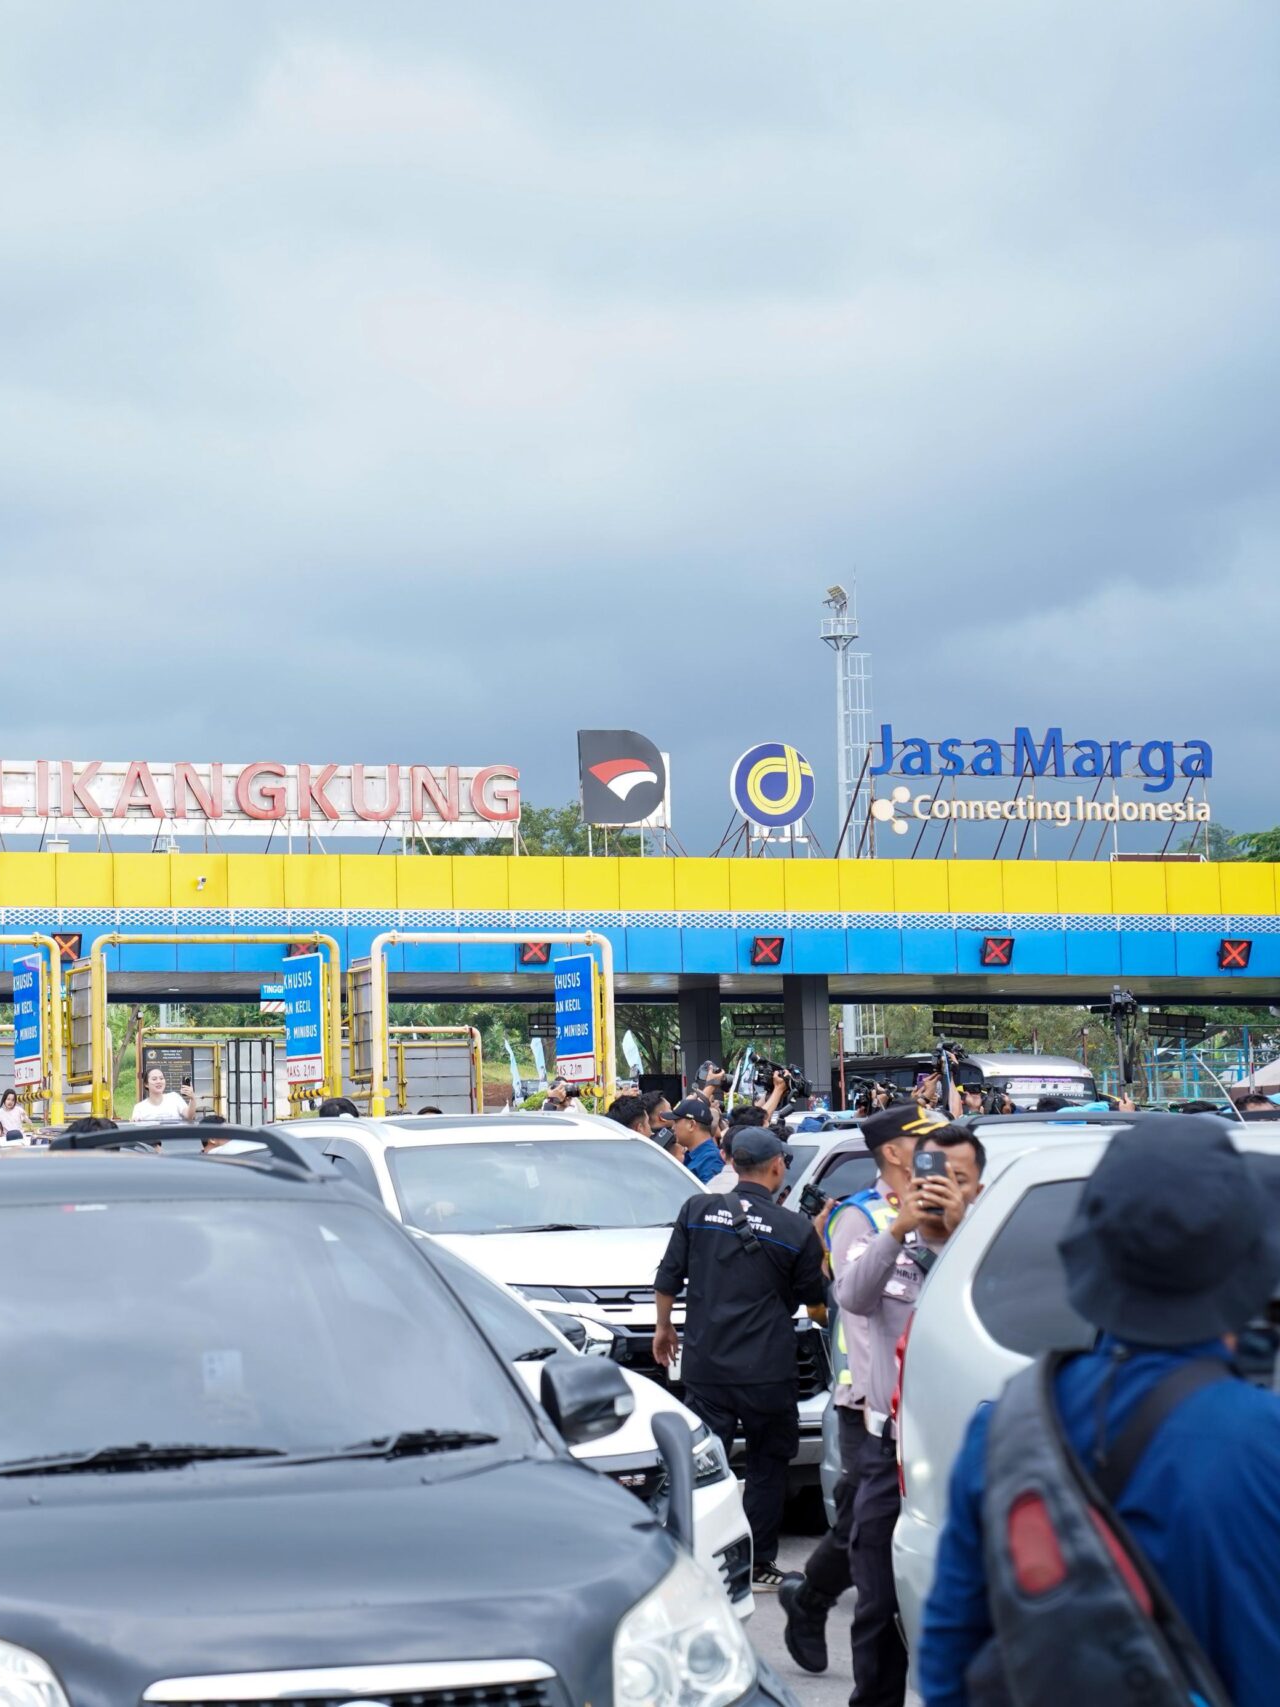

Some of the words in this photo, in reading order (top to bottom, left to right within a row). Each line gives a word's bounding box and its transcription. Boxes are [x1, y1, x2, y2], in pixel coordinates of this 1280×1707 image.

[870, 724, 1213, 793] JasaMarga
[913, 795, 1071, 827] Connecting
[1076, 796, 1211, 822] Indonesia
[263, 985, 284, 993] TINGGI
[294, 1025, 317, 1038] MINIBUS
[564, 1023, 588, 1037] MINIBUS
[704, 1214, 733, 1226] MEDIA
[750, 1223, 772, 1233] NTER
